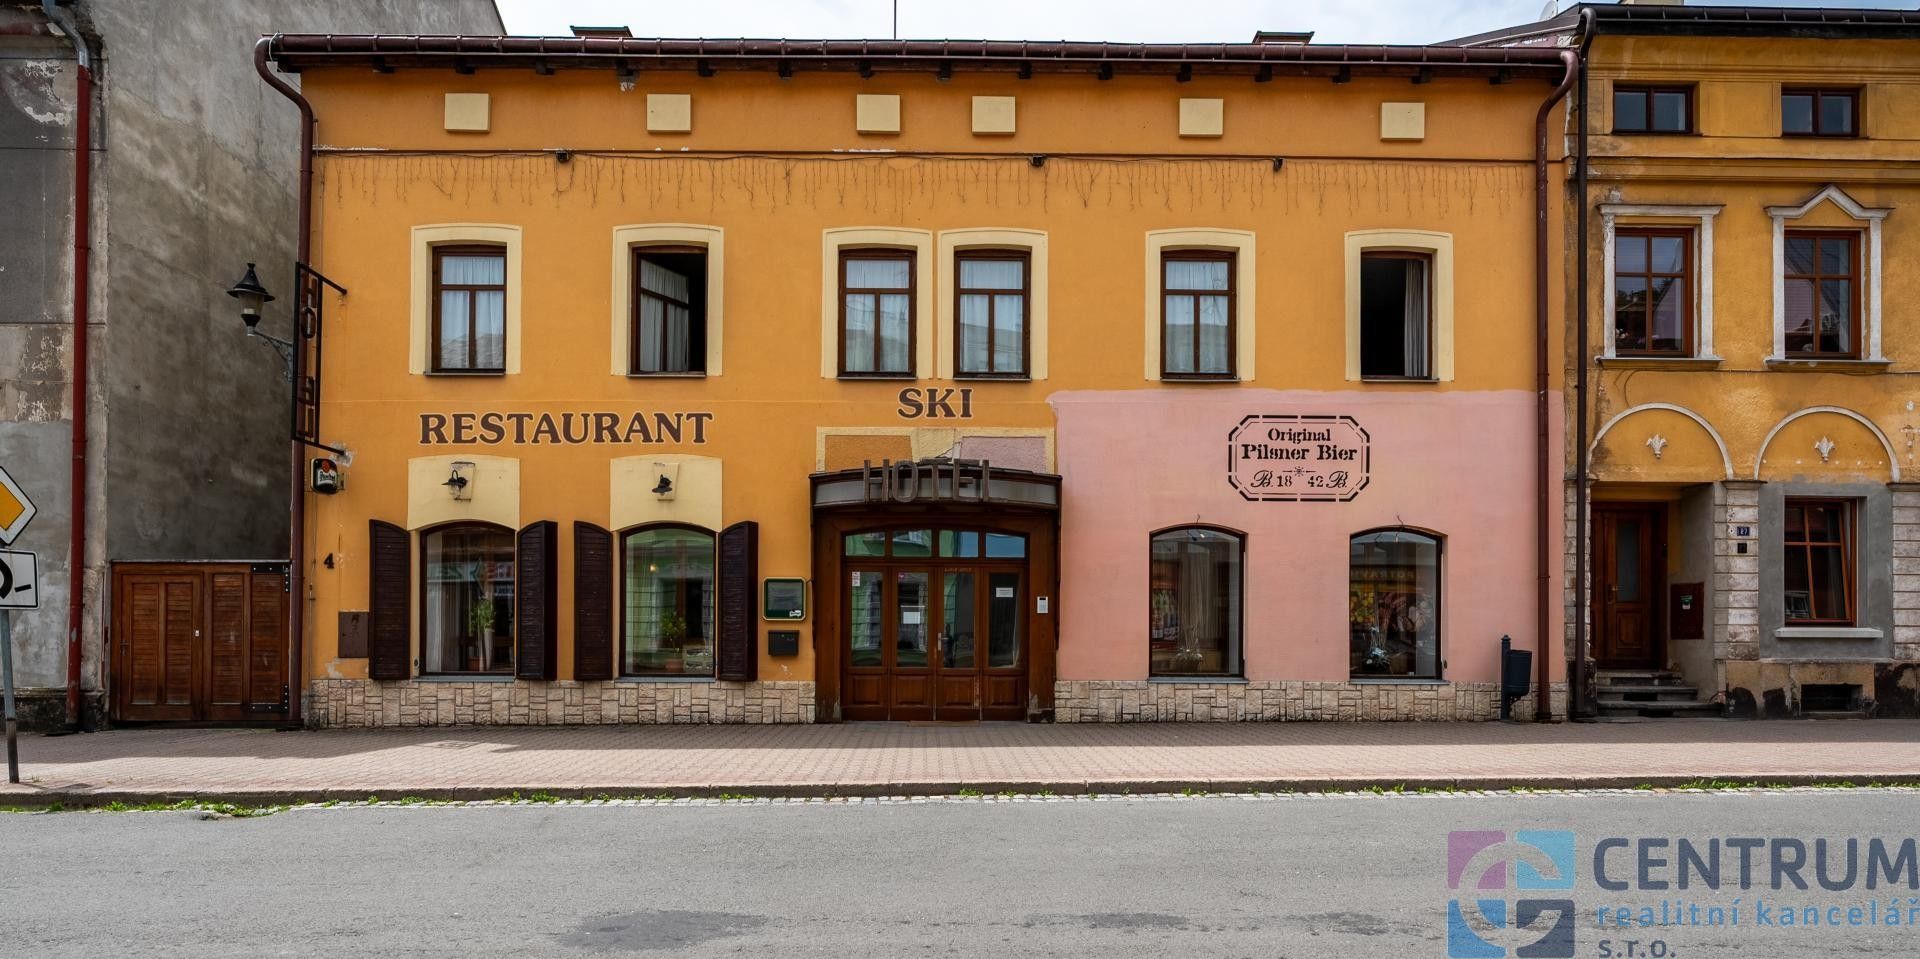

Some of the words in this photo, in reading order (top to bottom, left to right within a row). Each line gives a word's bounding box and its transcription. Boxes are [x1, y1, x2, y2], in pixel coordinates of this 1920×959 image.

[897, 387, 973, 419] SKI
[419, 411, 714, 444] RESTAURANT
[1267, 427, 1332, 445] Original
[1241, 443, 1310, 460] Pilsner
[1316, 444, 1358, 460] Bier
[863, 457, 1004, 503] HOTEL
[1276, 475, 1293, 487] 18
[1307, 475, 1324, 487] 42
[323, 552, 335, 569] 4
